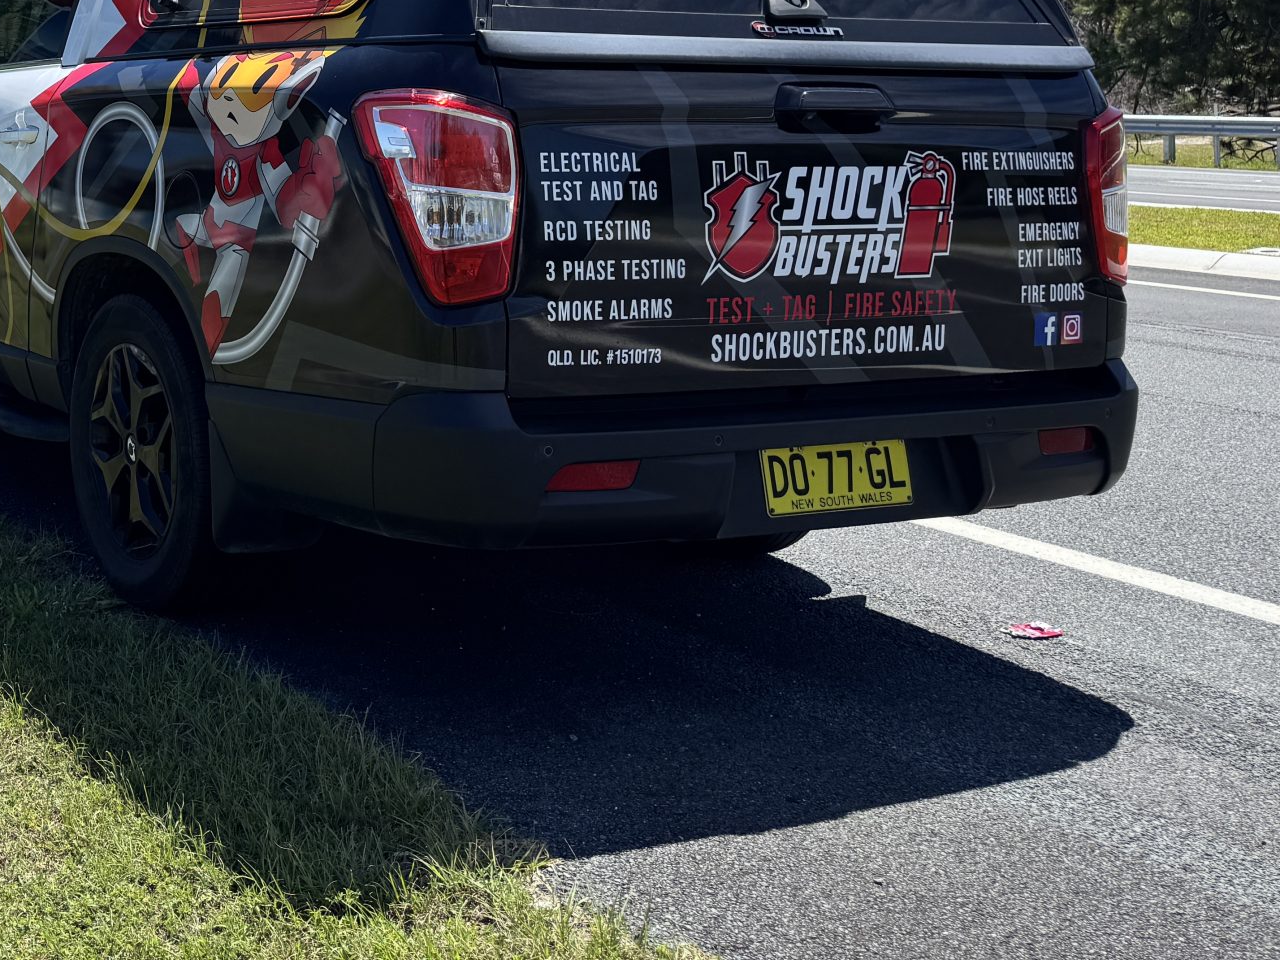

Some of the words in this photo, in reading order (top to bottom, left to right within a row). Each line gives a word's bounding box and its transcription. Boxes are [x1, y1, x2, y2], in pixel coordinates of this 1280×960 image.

[774, 25, 844, 36] CROWN
[539, 152, 641, 173] ELECTRICAL
[961, 152, 989, 171] FIRE
[993, 151, 1075, 170] EXTINGUISHERS
[541, 180, 583, 201] TEST
[590, 180, 624, 201] AND
[629, 180, 658, 201] TAG
[781, 166, 908, 233] SHOCK
[986, 187, 1014, 207] FIRE
[1017, 187, 1046, 206] HOSE
[1048, 186, 1078, 206] REELS
[543, 220, 578, 241] RCD
[583, 219, 651, 241] TESTING
[1018, 221, 1080, 242] EMERGENCY
[773, 233, 901, 285] BUSTERS
[1018, 249, 1044, 268] EXIT
[1047, 247, 1082, 267] LIGHTS
[545, 260, 556, 282] 3
[562, 260, 616, 281] PHASE
[621, 258, 686, 280] TESTING
[1021, 284, 1046, 304] FIRE
[1049, 282, 1085, 303] DOORS
[547, 300, 604, 322] SMOKE
[609, 298, 673, 321] ALARMS
[706, 296, 755, 324] TEST
[782, 294, 817, 321] TAG
[844, 291, 885, 318] FIRE
[891, 289, 957, 317] SAFETY
[710, 324, 946, 363] SHOCKBUSTERS.COM.AU
[547, 350, 574, 367] QLD.
[580, 349, 602, 366] LIC.
[606, 348, 662, 365] #1510173
[791, 499, 815, 511] NEW
[819, 495, 855, 508] SOUTH
[858, 491, 893, 505] WALES
